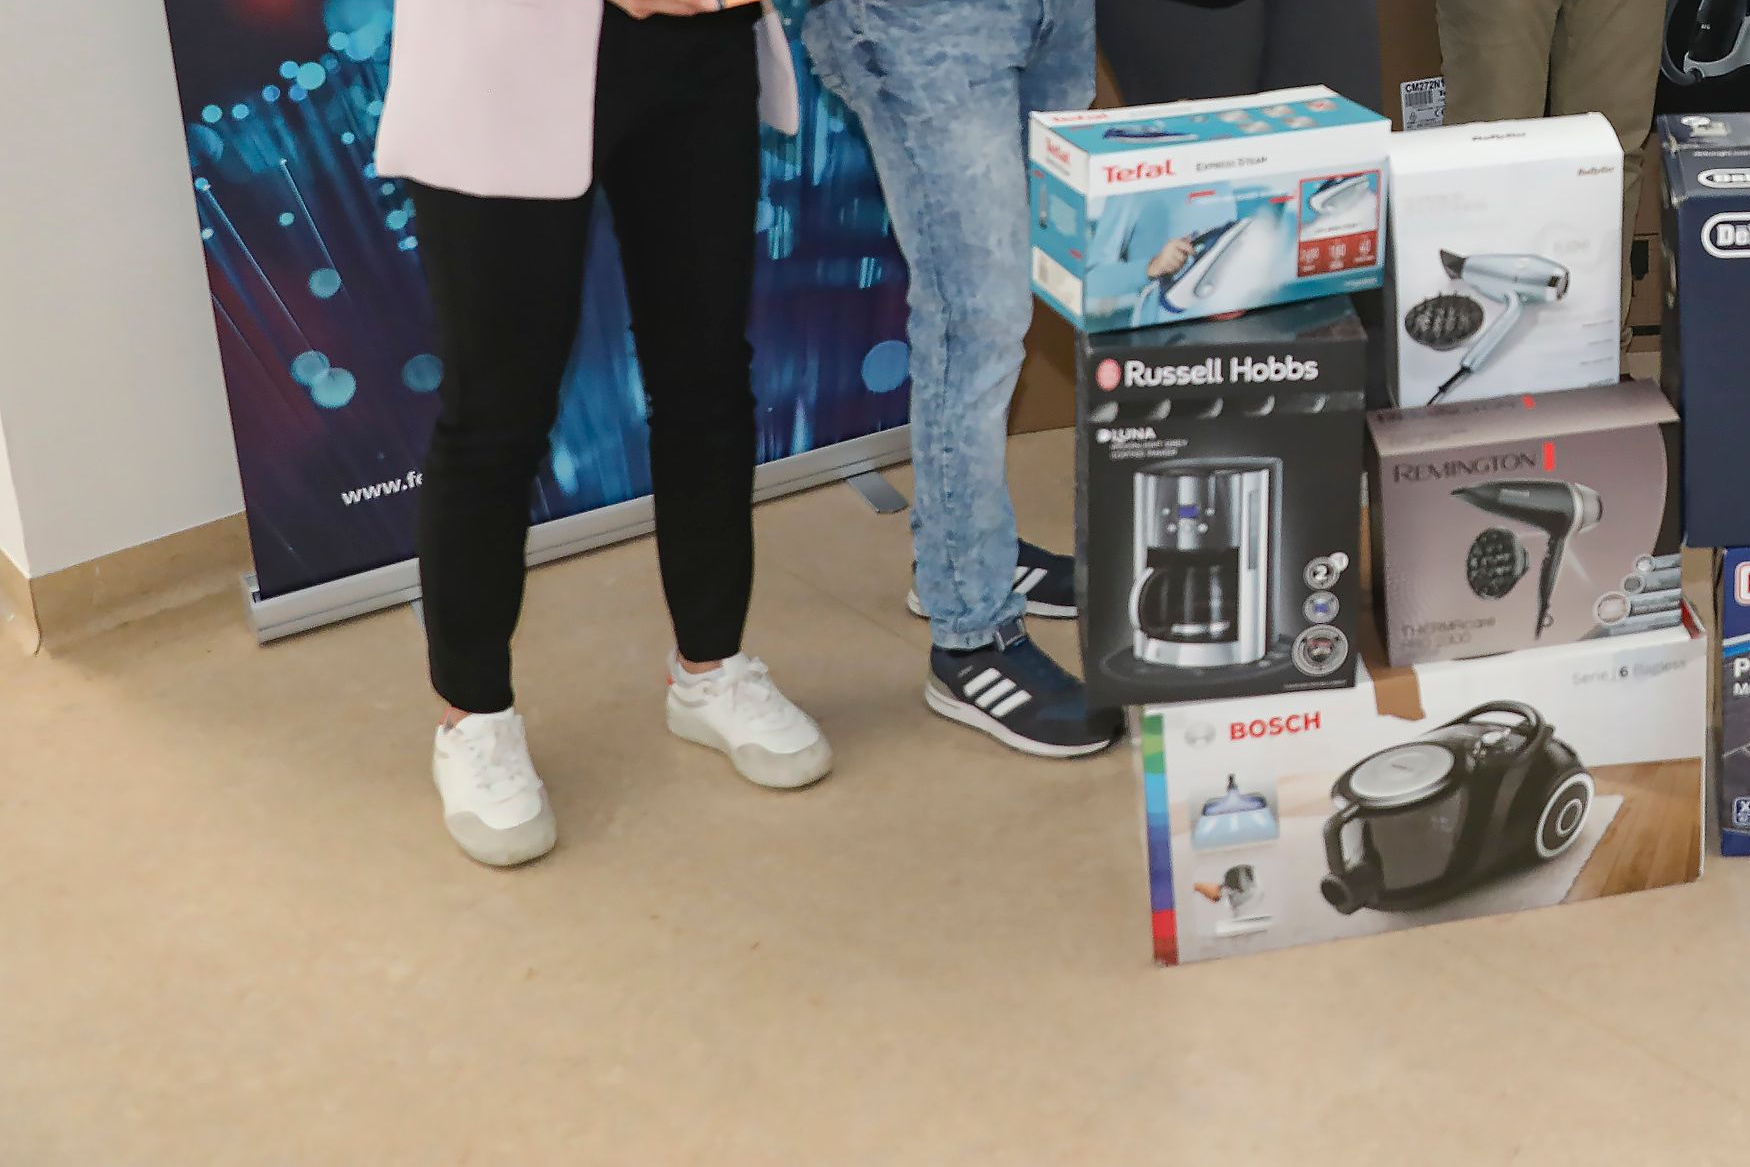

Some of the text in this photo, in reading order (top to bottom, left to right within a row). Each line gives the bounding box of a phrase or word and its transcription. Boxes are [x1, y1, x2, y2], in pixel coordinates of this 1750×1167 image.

[1103, 159, 1176, 184] Tefal
[1123, 354, 1319, 388] Russell Hobbs
[1393, 452, 1538, 484] REMINGTON
[1619, 665, 1629, 678] 6
[1229, 710, 1322, 741] BOSCH
